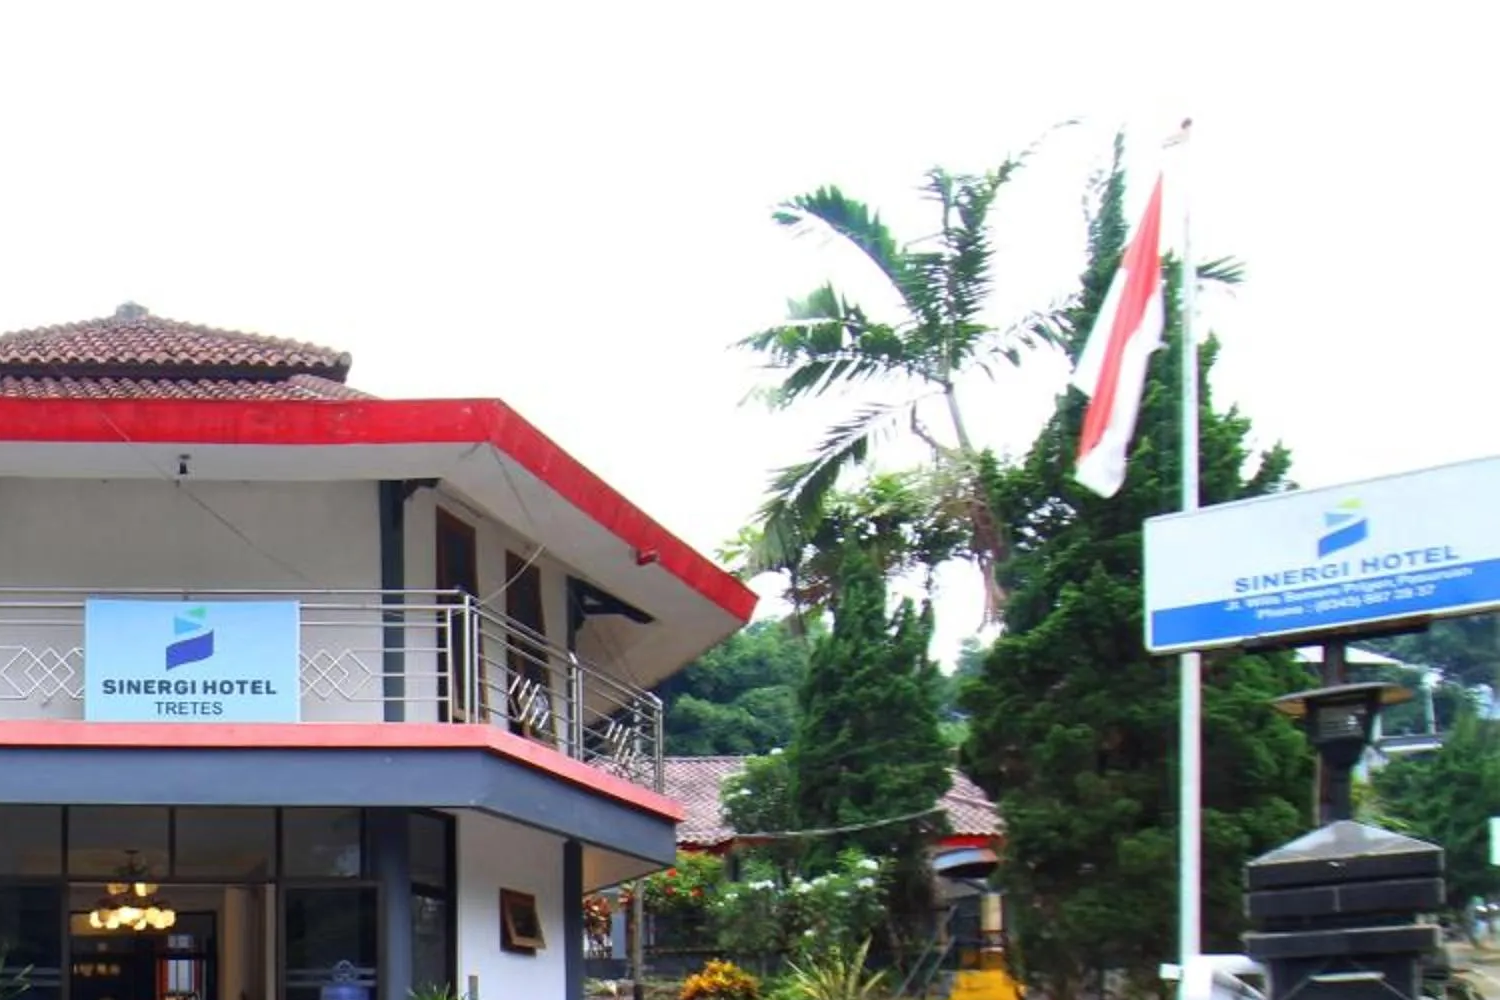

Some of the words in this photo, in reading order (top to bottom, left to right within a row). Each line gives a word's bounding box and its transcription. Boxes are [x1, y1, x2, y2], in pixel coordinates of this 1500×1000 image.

[1235, 562, 1350, 593] SINERGI
[1361, 544, 1460, 574] HOTEL
[102, 679, 196, 695] SINERGI
[203, 679, 277, 695] HOTEL
[155, 701, 223, 715] TRETES
